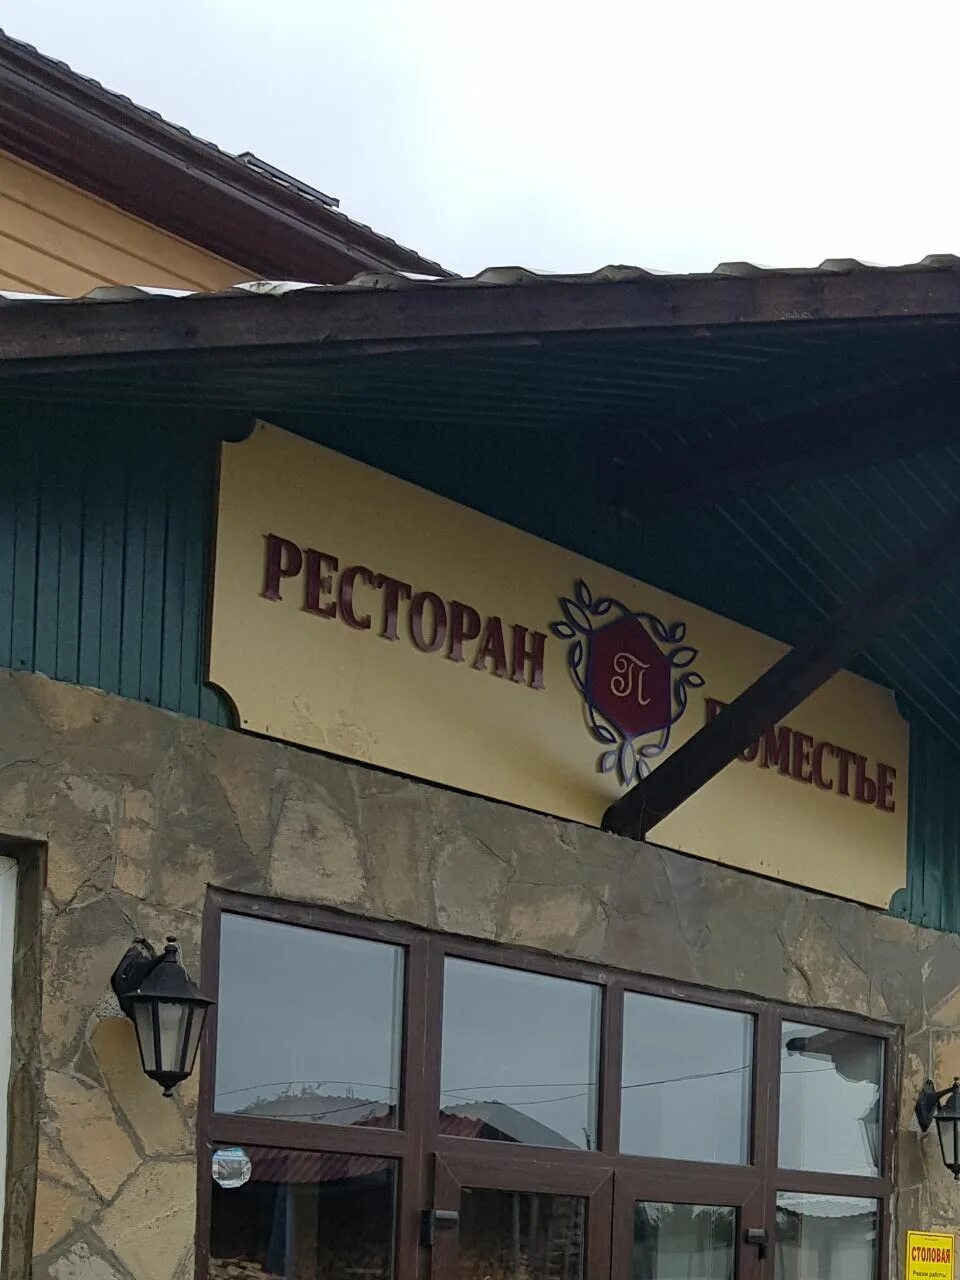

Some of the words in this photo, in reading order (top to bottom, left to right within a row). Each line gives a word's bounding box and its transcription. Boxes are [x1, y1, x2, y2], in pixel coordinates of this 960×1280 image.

[260, 533, 548, 690] РЕСТОРАН
[611, 653, 651, 705] П
[911, 1246, 951, 1264] СТОЛОВАЯ
